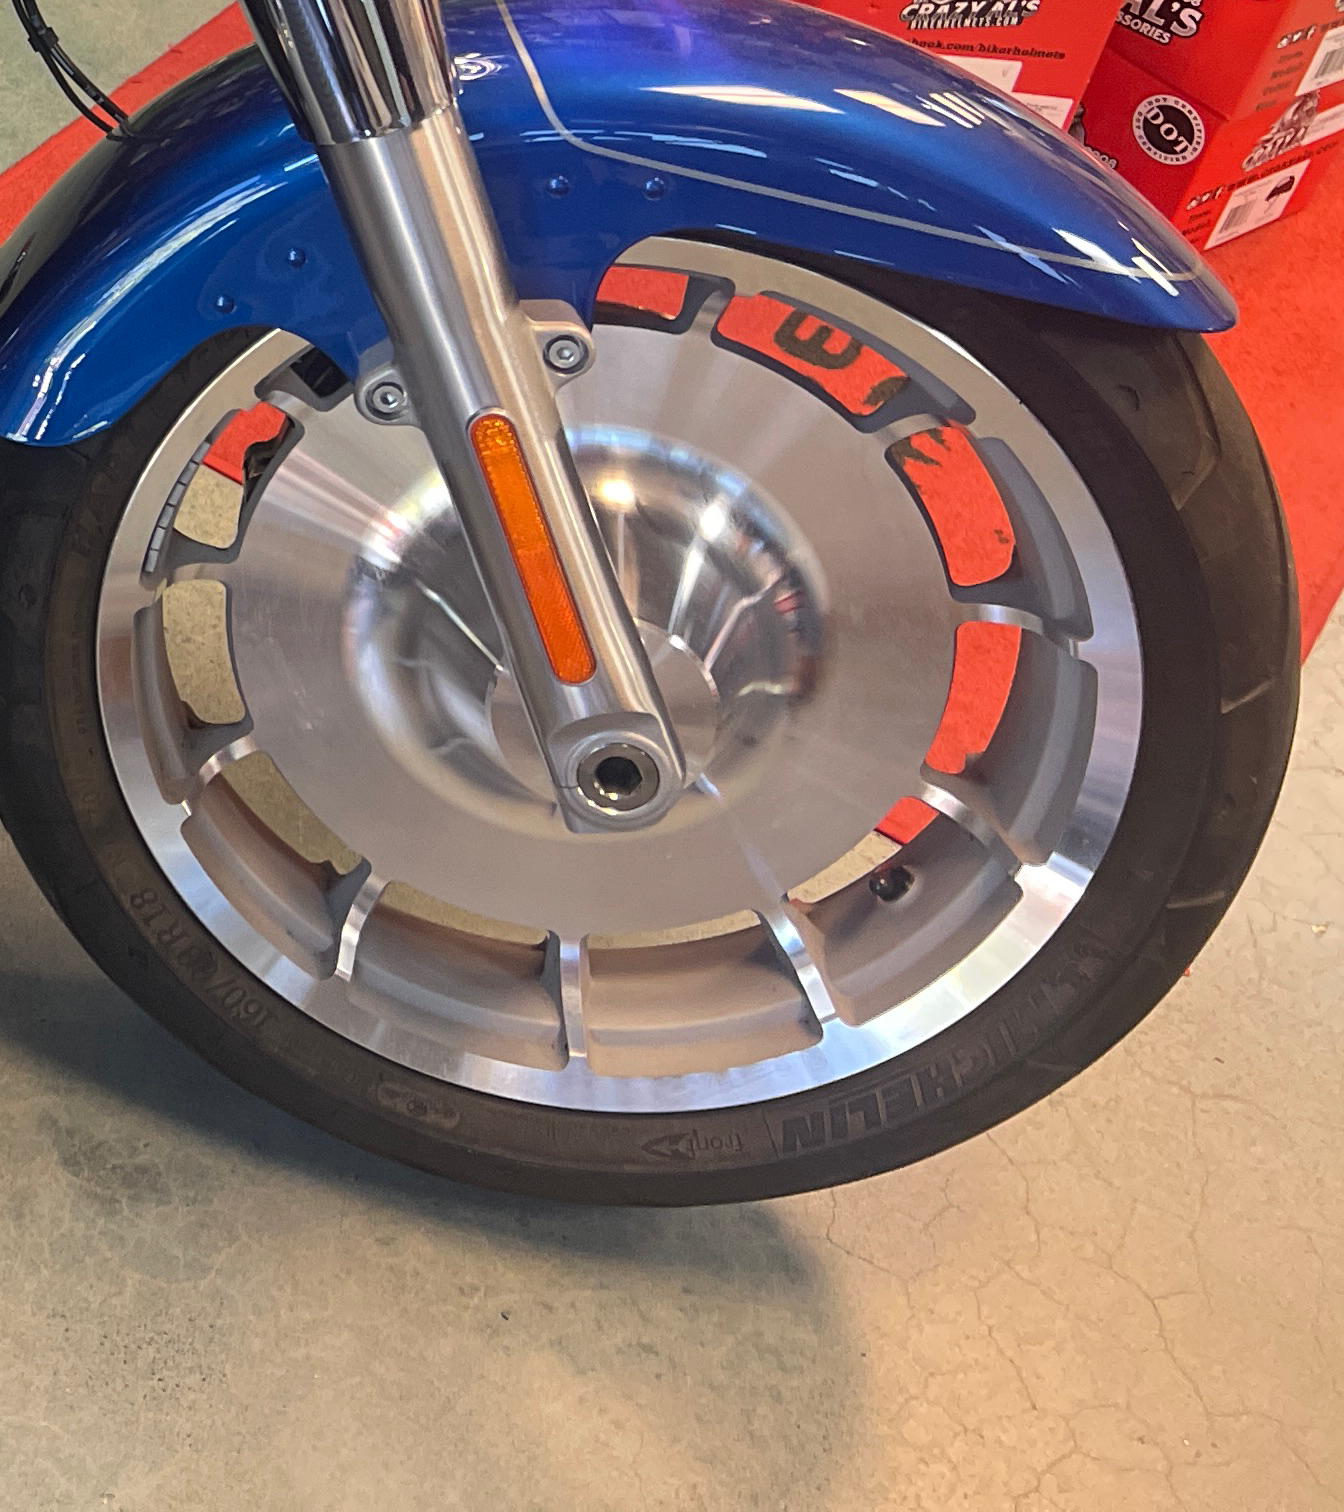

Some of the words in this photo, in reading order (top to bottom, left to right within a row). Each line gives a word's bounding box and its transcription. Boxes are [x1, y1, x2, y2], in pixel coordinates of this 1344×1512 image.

[900, 0, 987, 23] CRAZY
[988, 0, 1041, 20] AL'S
[1143, 104, 1190, 155] DOT
